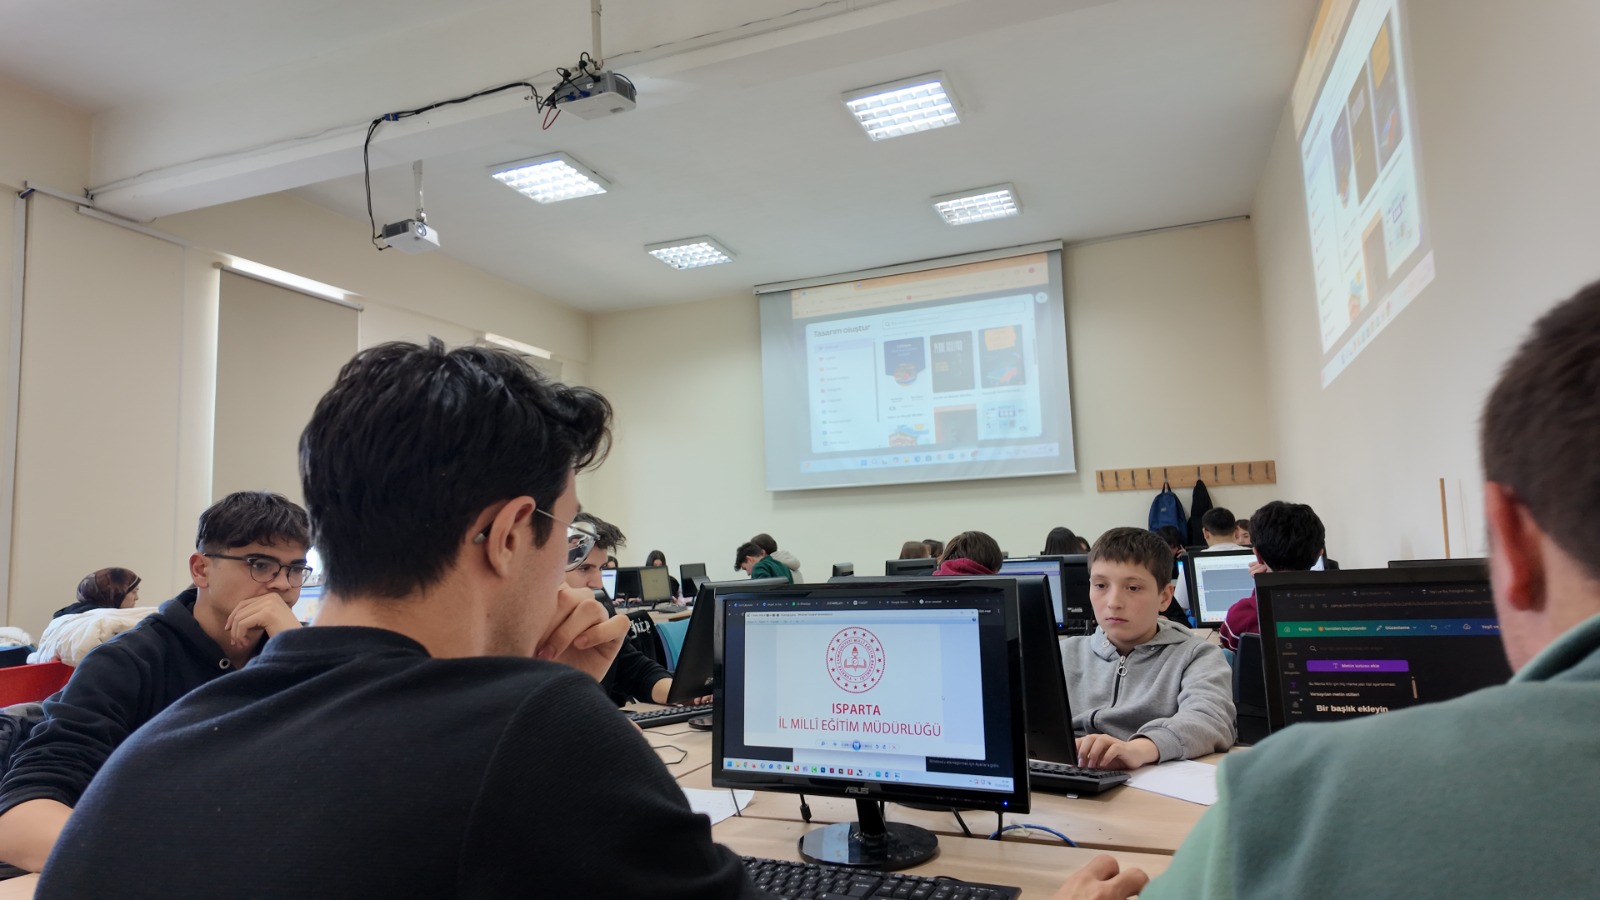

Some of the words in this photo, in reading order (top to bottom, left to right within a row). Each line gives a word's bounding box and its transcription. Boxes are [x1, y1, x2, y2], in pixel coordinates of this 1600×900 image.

[832, 703, 881, 716] ISPARTA
[1316, 704, 1329, 712] Bir
[1330, 704, 1356, 714] başlık
[1357, 704, 1389, 714] ekleyin
[778, 715, 788, 729] İL
[821, 717, 859, 732] EĞİTİM
[862, 719, 941, 737] MÜDÜRLÜĞÜ
[844, 786, 869, 795] ASUS
